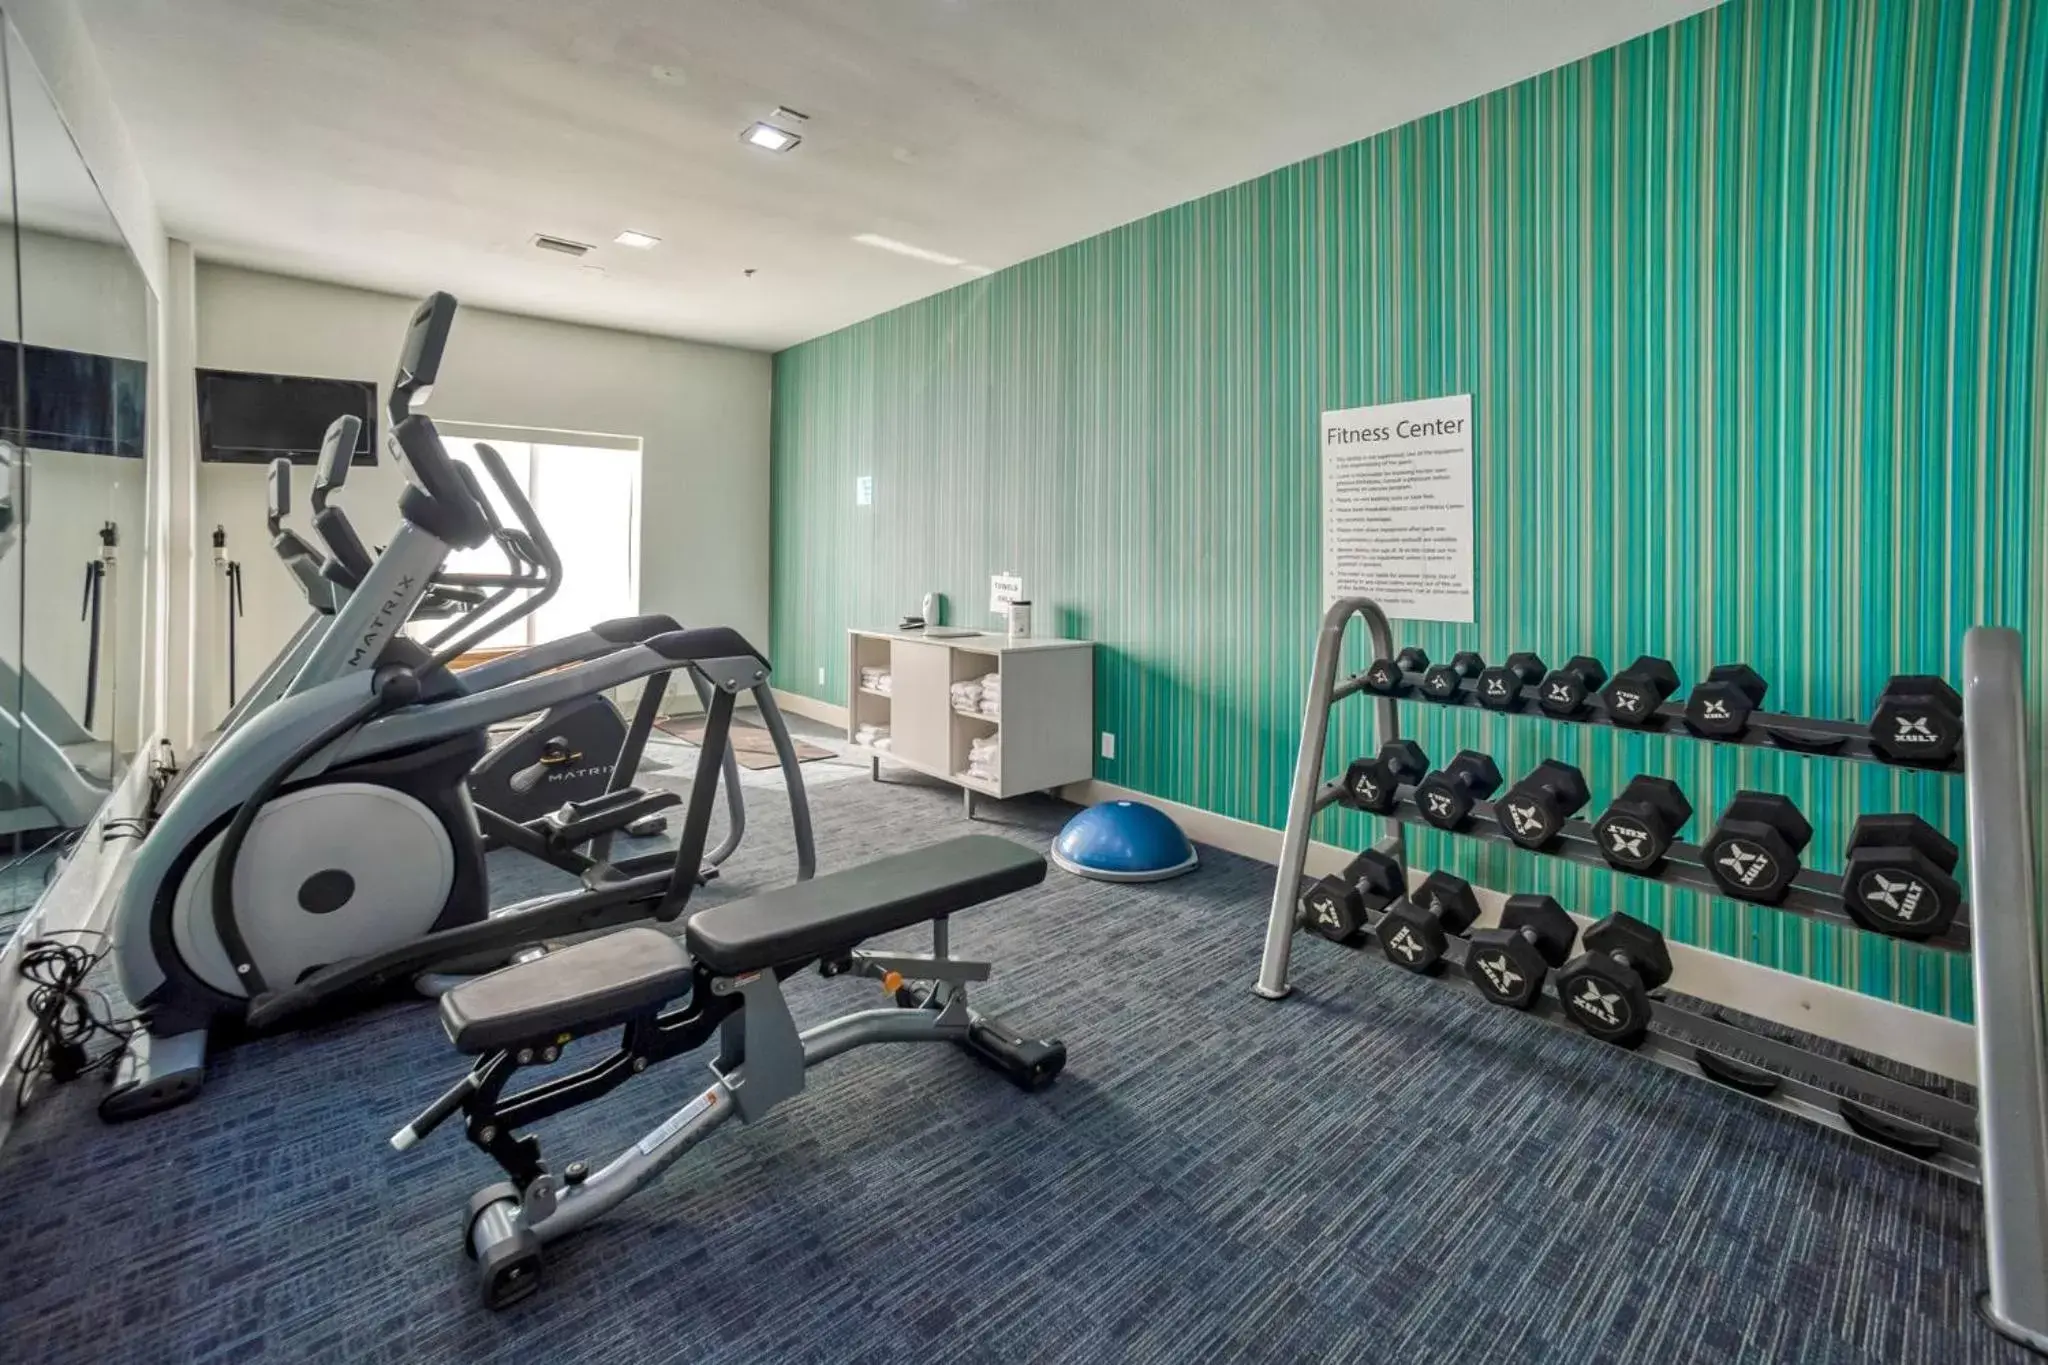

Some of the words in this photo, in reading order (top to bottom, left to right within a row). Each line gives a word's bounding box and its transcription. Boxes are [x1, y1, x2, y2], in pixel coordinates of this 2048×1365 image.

[1327, 426, 1390, 446] Fitness
[1396, 418, 1465, 439] Center
[348, 574, 414, 666] MATRIX
[1740, 854, 1769, 885] XULT
[1898, 881, 1924, 920] XULT
